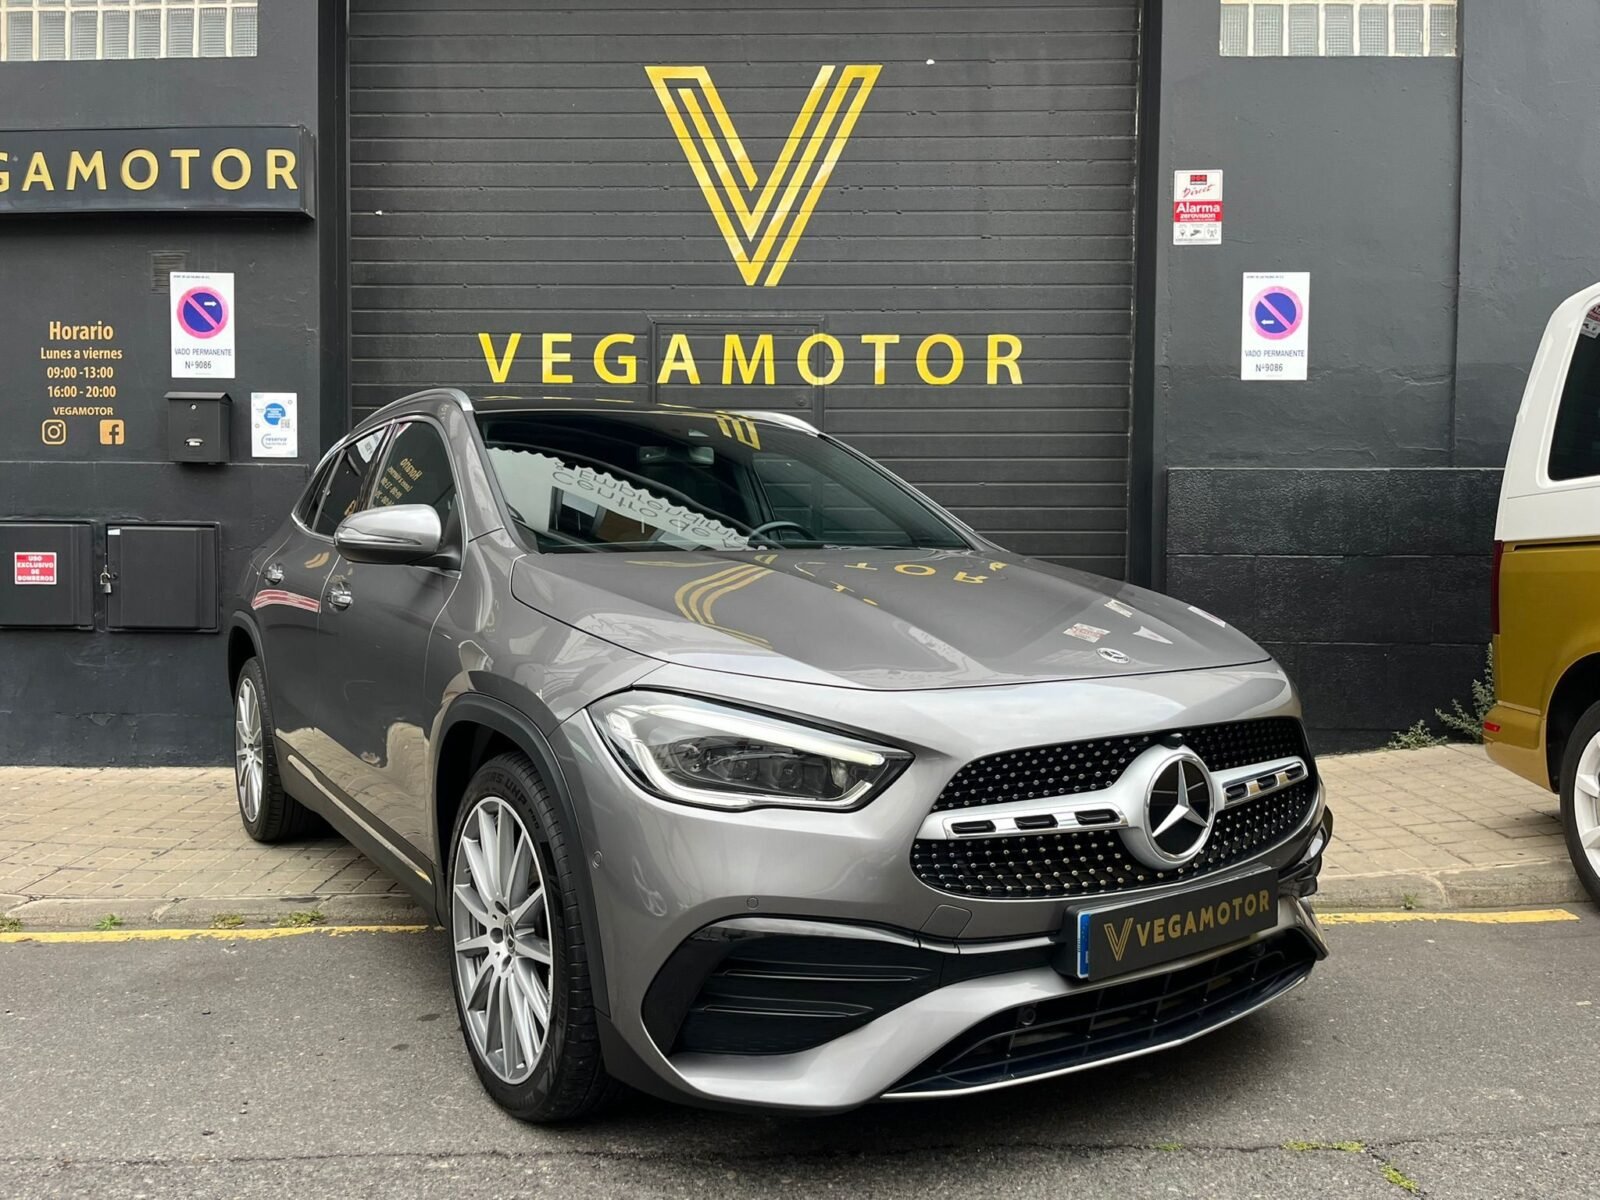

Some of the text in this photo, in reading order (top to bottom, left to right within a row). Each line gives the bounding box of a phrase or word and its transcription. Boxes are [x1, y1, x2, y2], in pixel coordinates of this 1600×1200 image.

[1176, 201, 1221, 213] Alarma
[49, 321, 114, 340] Horario
[40, 347, 123, 360] Lunes a viernes
[174, 348, 232, 357] VADO PERMANENTE
[1244, 349, 1305, 358] VADO PERMANENTE
[478, 333, 1024, 386] VEGAMOTOR
[46, 366, 77, 379] 09:00
[47, 385, 77, 398] 16:00
[85, 385, 117, 398] 20:00
[52, 406, 114, 416] VEGAMOTOR
[1136, 889, 1270, 947] VEGAMOTOR
